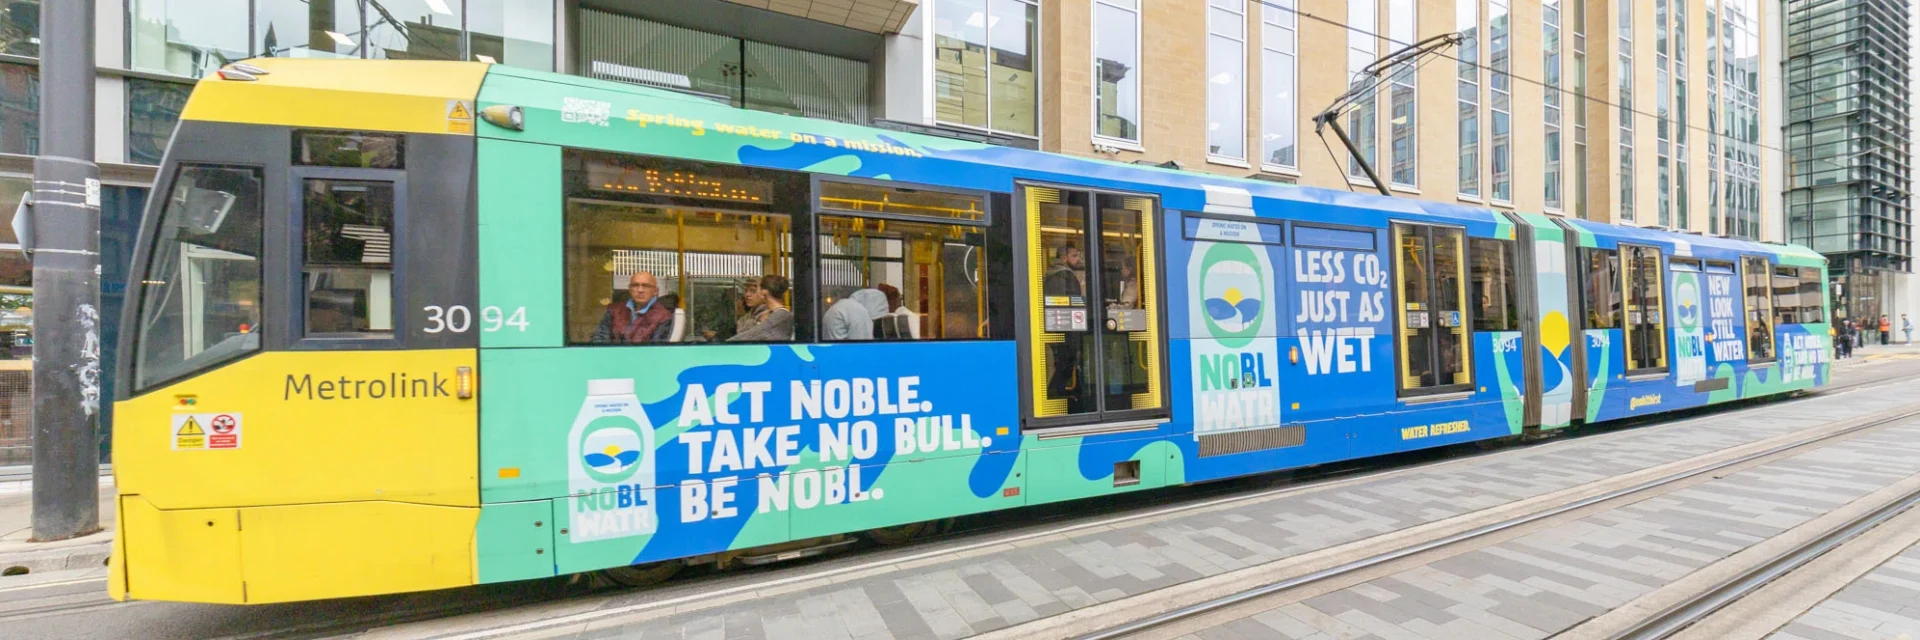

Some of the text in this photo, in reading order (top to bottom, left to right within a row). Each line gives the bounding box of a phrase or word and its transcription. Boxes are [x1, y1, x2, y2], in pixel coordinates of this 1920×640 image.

[625, 108, 923, 158] Spring water on a mission.
[1294, 249, 1346, 283] LESS
[1708, 275, 1730, 296] NEW
[1296, 290, 1350, 323] JUST
[1358, 291, 1385, 323] AS
[1710, 297, 1734, 318] LOOK
[1492, 338, 1517, 353] 3094
[1711, 319, 1736, 340] STILL
[1297, 326, 1376, 376] WET
[1678, 334, 1703, 358] NOBL
[1713, 340, 1744, 362] WATER
[284, 372, 450, 401] Metrolink
[1199, 352, 1272, 392] NOBL
[678, 376, 933, 427] ACT NOBLE.
[1201, 389, 1275, 432] WATR
[679, 413, 992, 475] TAKE NO BULL.
[1402, 425, 1428, 441] WATER
[577, 483, 648, 513] NOBL
[680, 464, 884, 523] BE NOBL.
[577, 506, 649, 538] WATR
